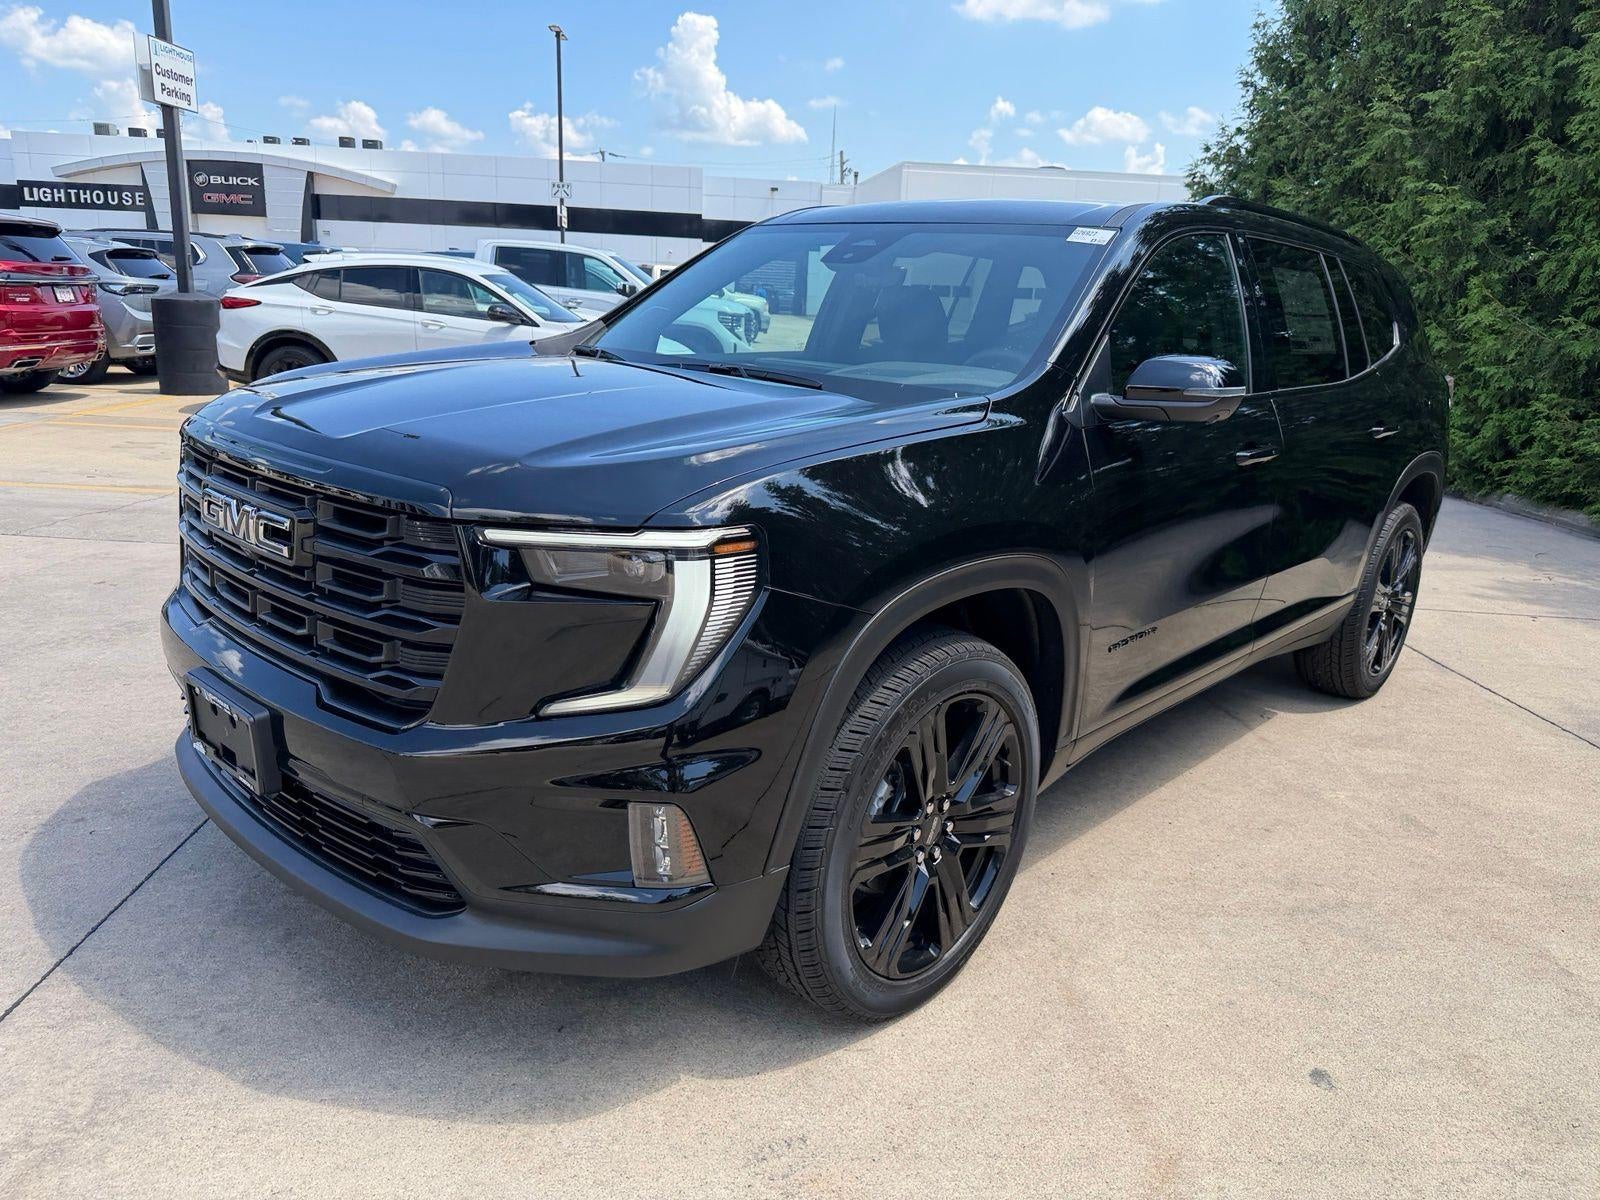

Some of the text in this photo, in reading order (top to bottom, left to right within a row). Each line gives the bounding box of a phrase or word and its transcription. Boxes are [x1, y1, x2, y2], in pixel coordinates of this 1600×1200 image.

[155, 62, 193, 86] Customer
[161, 82, 191, 106] Parking
[209, 175, 260, 186] BUICK
[23, 187, 145, 206] LIGHTHOUSE
[203, 192, 253, 205] GMC
[201, 487, 291, 559] GMC
